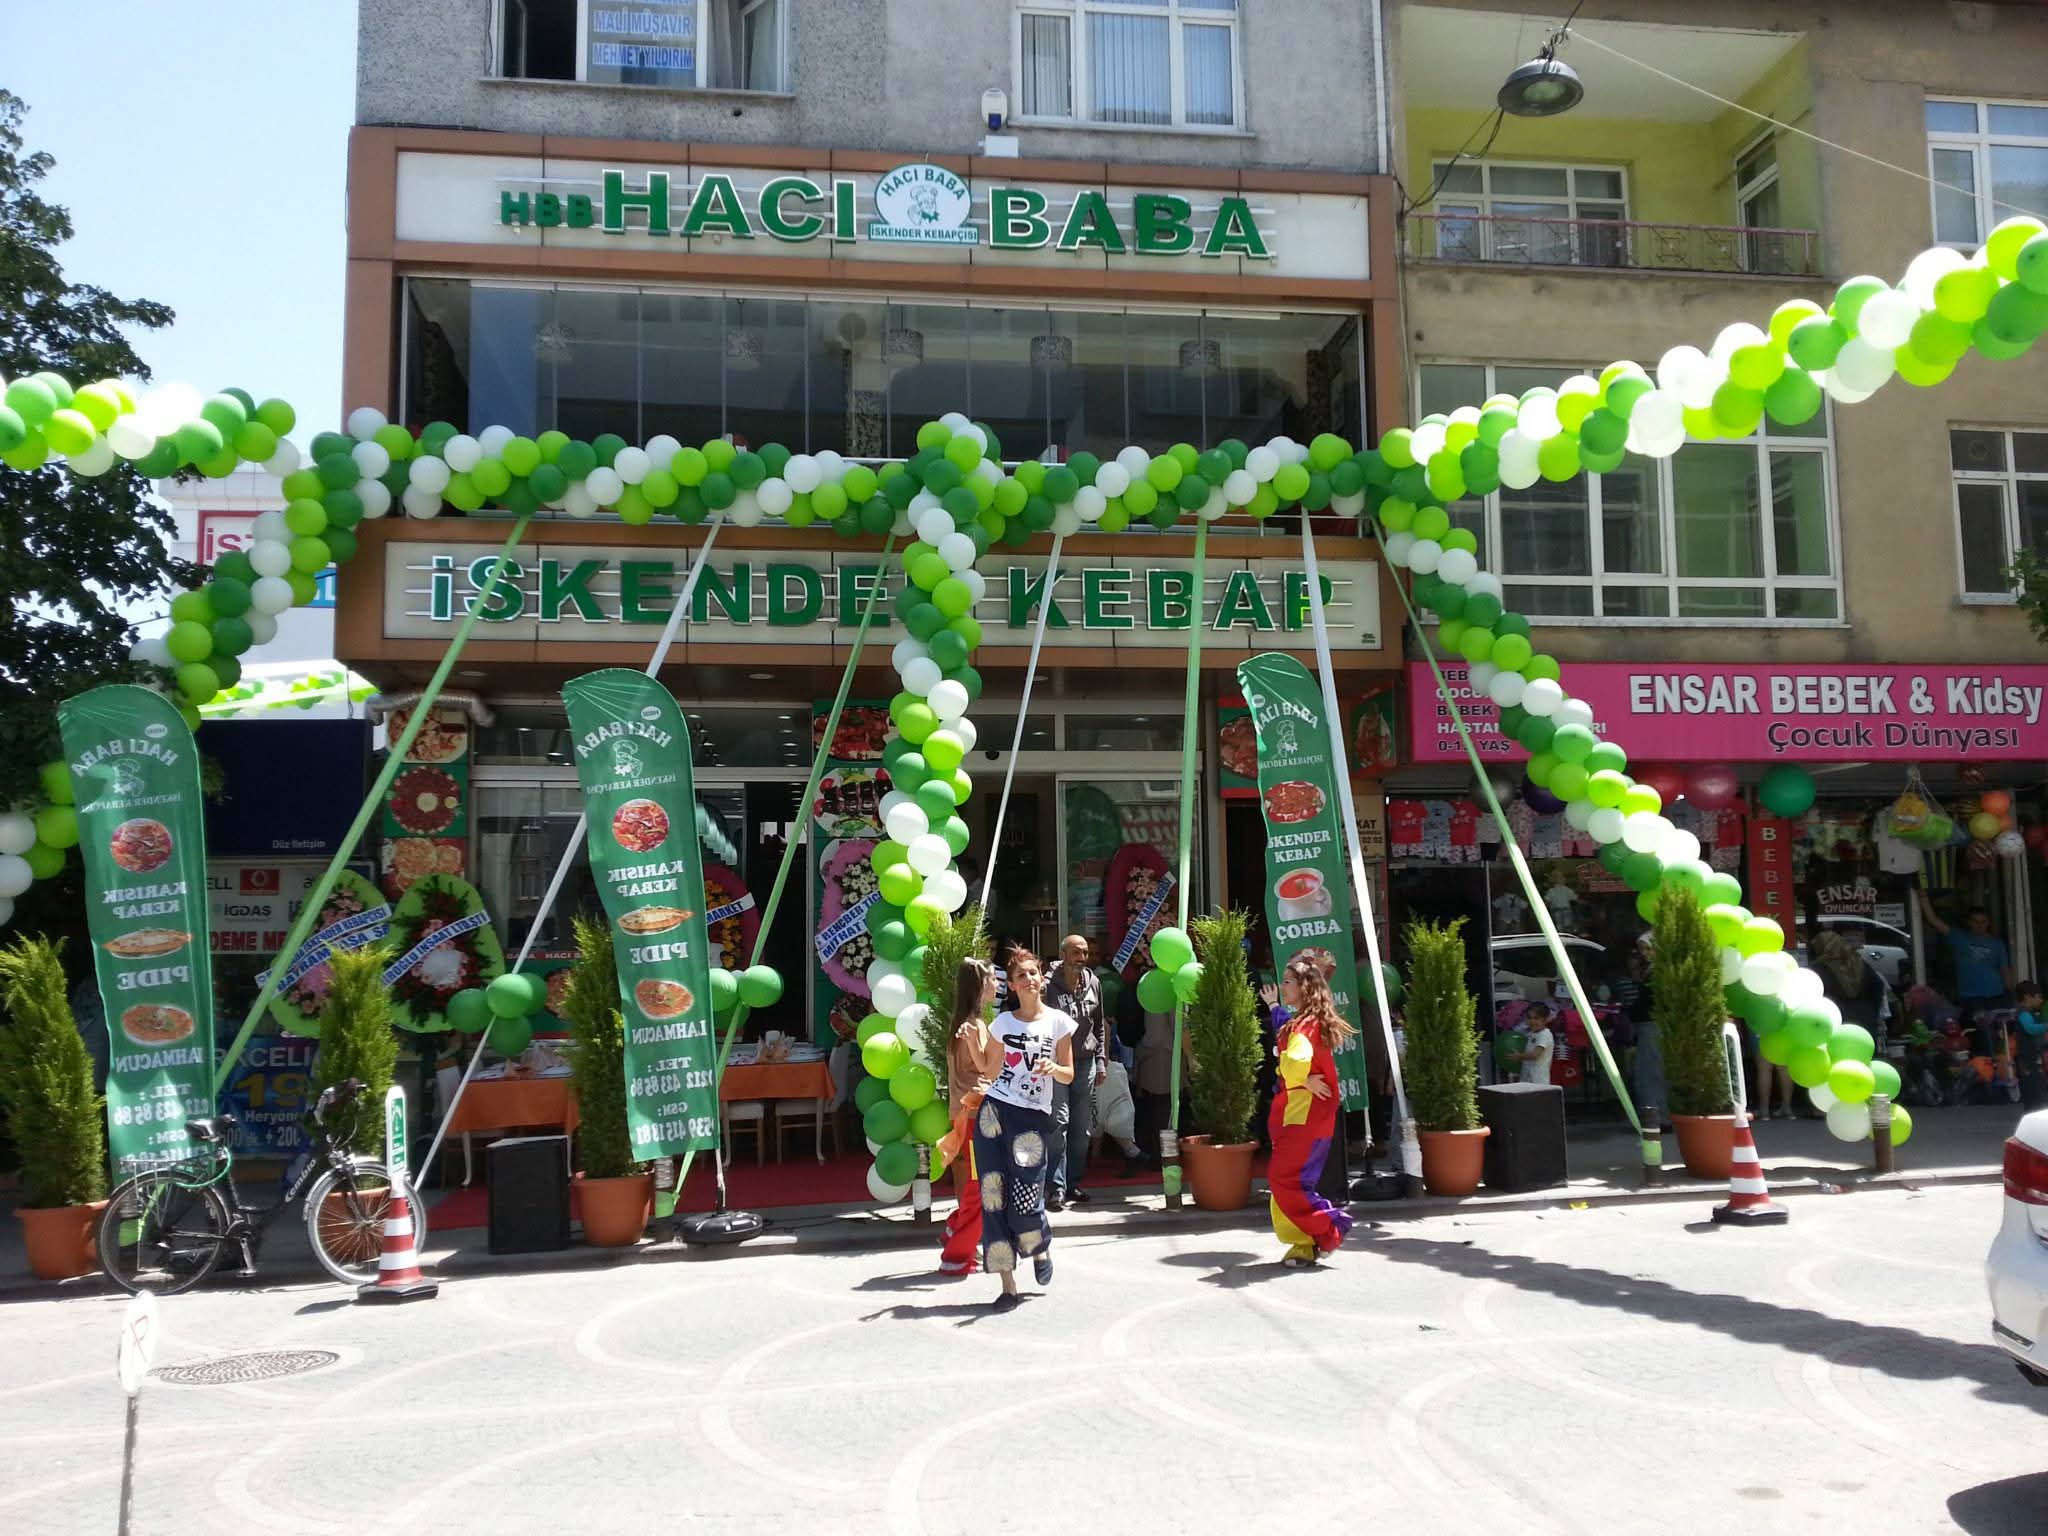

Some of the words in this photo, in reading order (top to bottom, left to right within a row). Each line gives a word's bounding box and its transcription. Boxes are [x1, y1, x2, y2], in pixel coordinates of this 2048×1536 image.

[593, 44, 640, 64] MEHMET
[642, 48, 693, 68] YILDIRIM
[881, 168, 918, 197] HACI
[925, 168, 965, 201] BABA
[500, 191, 593, 228] HBB
[602, 169, 857, 243] HACI
[988, 186, 1273, 260] BABA
[871, 226, 921, 239] İSKENDER
[1007, 566, 1333, 632] KEBAP
[1437, 705, 1494, 716] BBEK
[1630, 675, 1760, 713] ENSAR
[1770, 676, 1897, 714] BEBEK
[1909, 676, 1935, 714] &
[1946, 677, 2043, 724] Kidsy
[1281, 702, 1319, 729] BABA
[1480, 741, 1510, 754] YAŞ
[1767, 721, 1874, 752] Çocuk
[1885, 722, 2019, 752] Dünyası
[1267, 830, 1331, 849] SKENDER
[1274, 847, 1321, 863] KEBAP
[1816, 885, 1878, 905] ENSAR
[1825, 903, 1873, 914] OYUNCAK
[1275, 919, 1342, 944] ÇORBA
